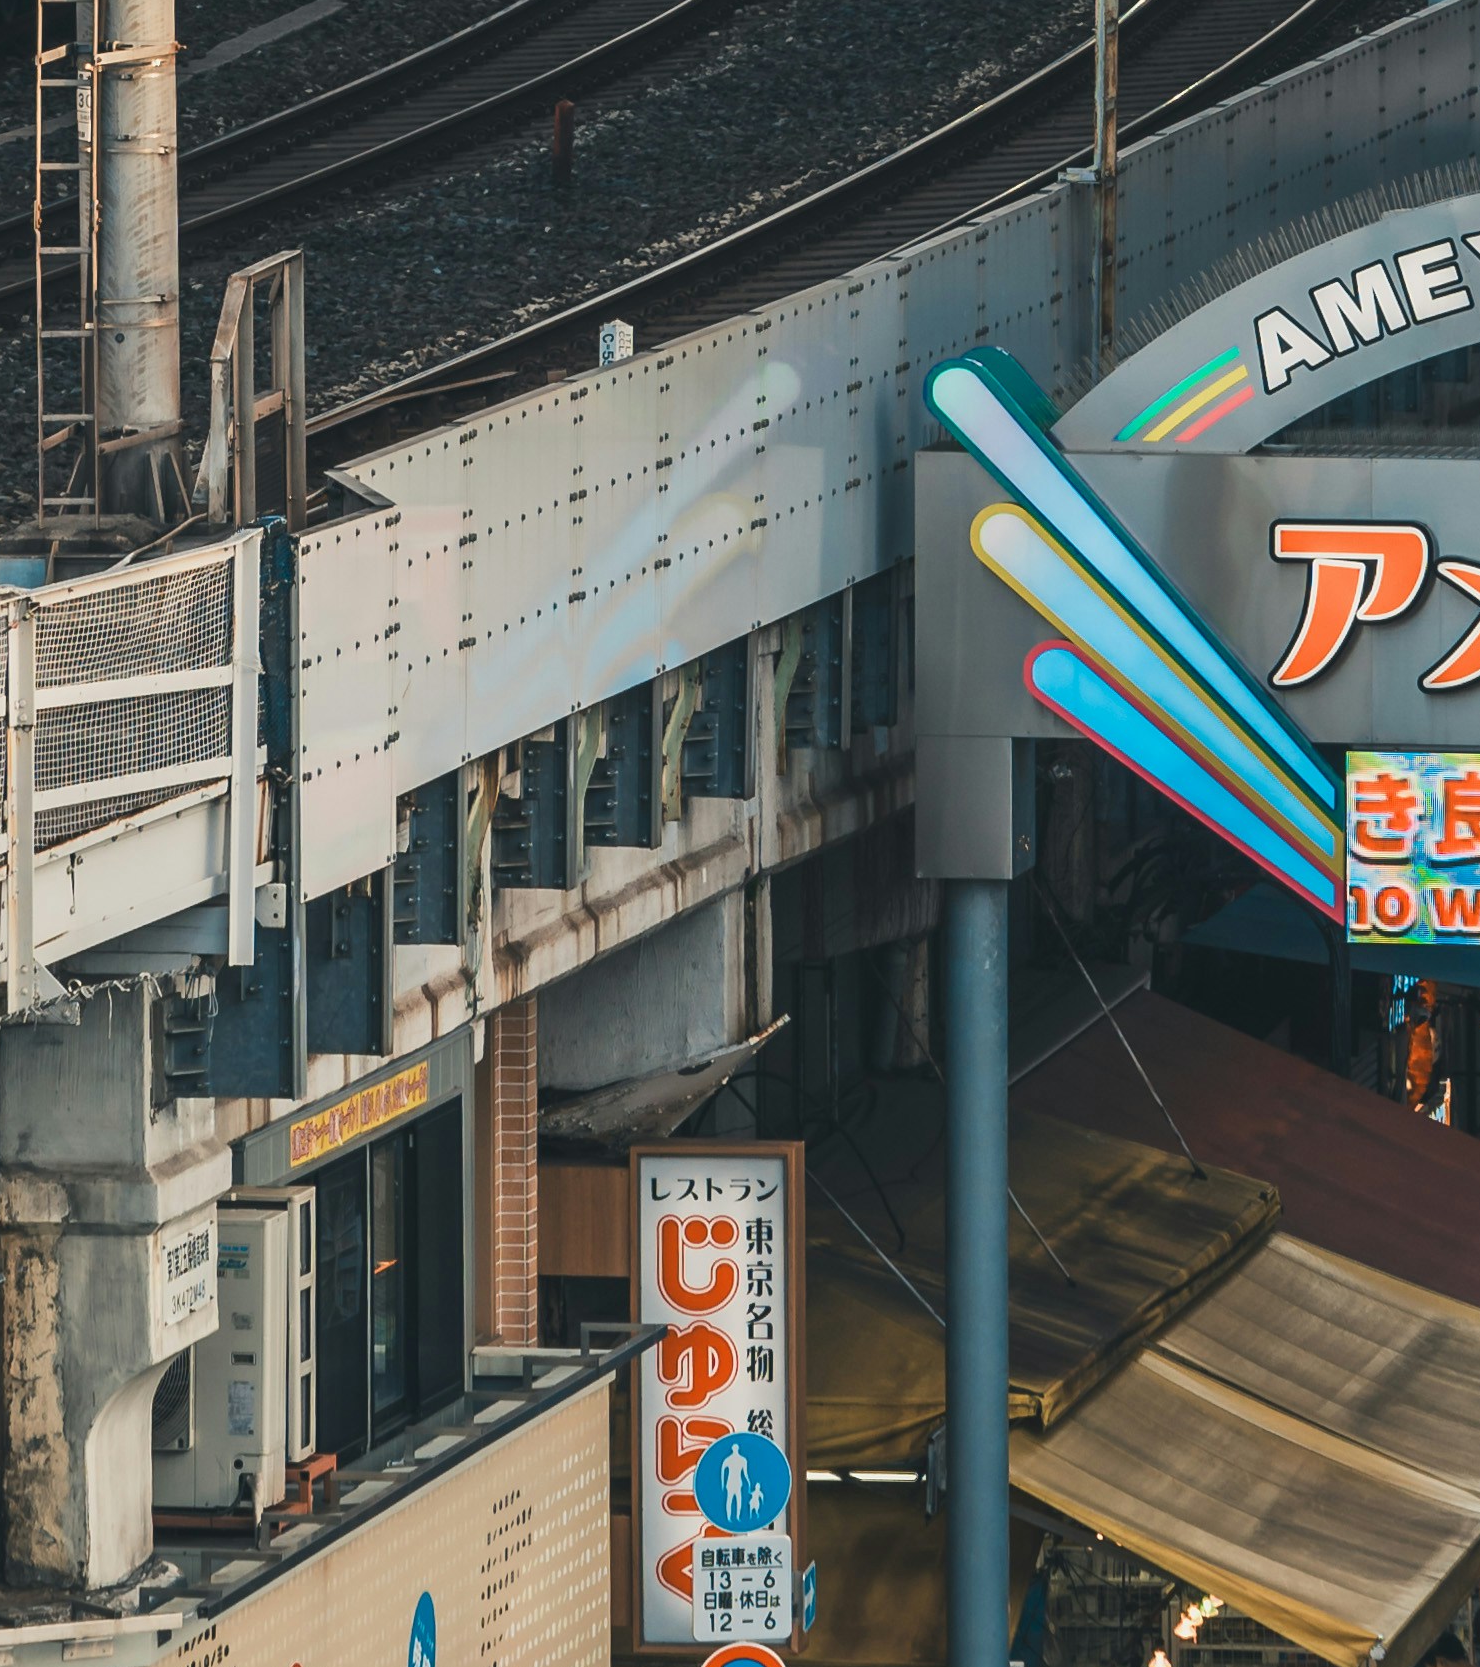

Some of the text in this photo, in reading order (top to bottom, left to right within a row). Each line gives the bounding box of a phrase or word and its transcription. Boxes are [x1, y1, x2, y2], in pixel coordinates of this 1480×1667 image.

[651, 1177, 780, 1204] レストラン
[745, 1217, 775, 1383] 東京名物
[700, 1547, 783, 1569] 自転車を除く
